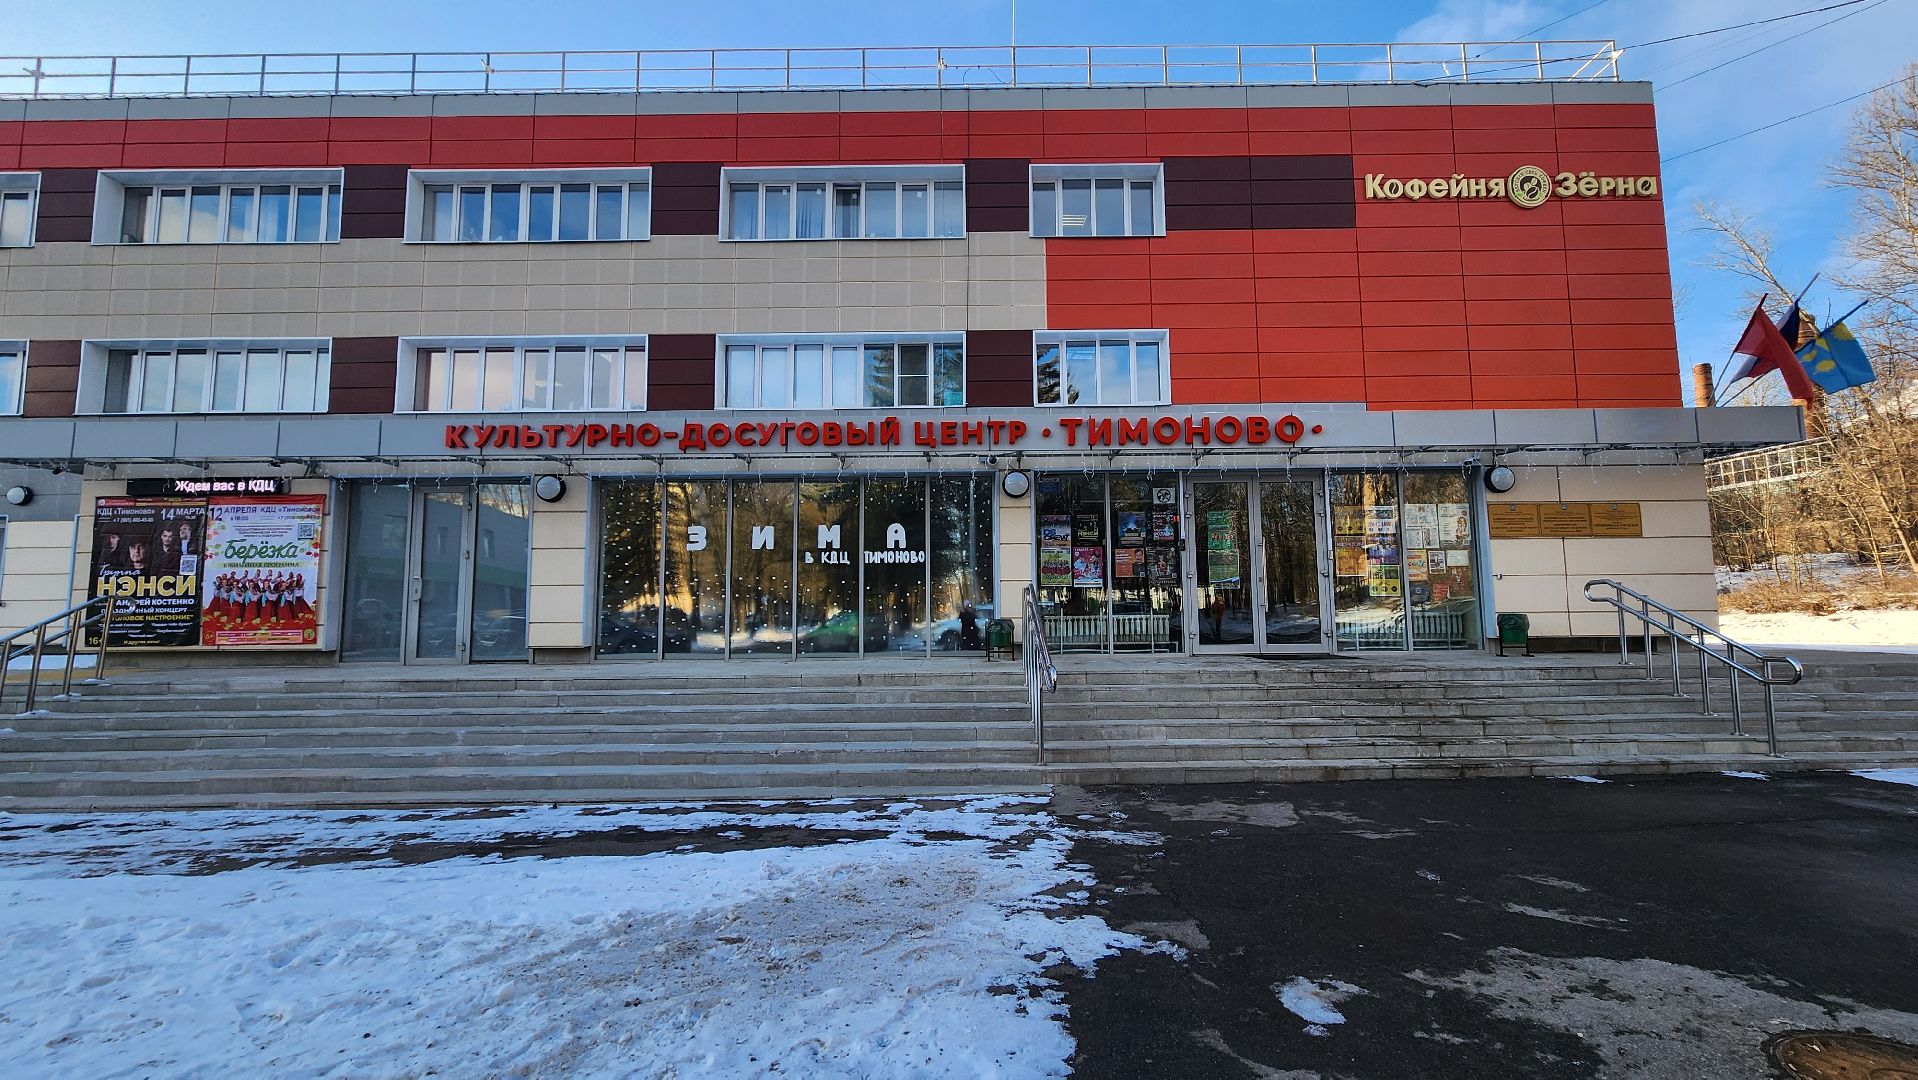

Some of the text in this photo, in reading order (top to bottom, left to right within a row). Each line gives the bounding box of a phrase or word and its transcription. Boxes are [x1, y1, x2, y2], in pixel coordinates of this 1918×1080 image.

[1364, 172, 1657, 200] Кофейня Зёрна
[445, 415, 1304, 451] КУЛЬТУРНО-ДОСУГОВЫЙ ЦЕНТР ТИМОНОВО
[175, 480, 275, 493] Ждем вас в КДЦ
[97, 508, 112, 516] КДЦ
[161, 508, 175, 520] 14
[209, 508, 222, 521] 12
[821, 551, 850, 565] КДЦ
[864, 551, 925, 563] ТИМОНОВО
[96, 575, 196, 597] НЭНСИ
